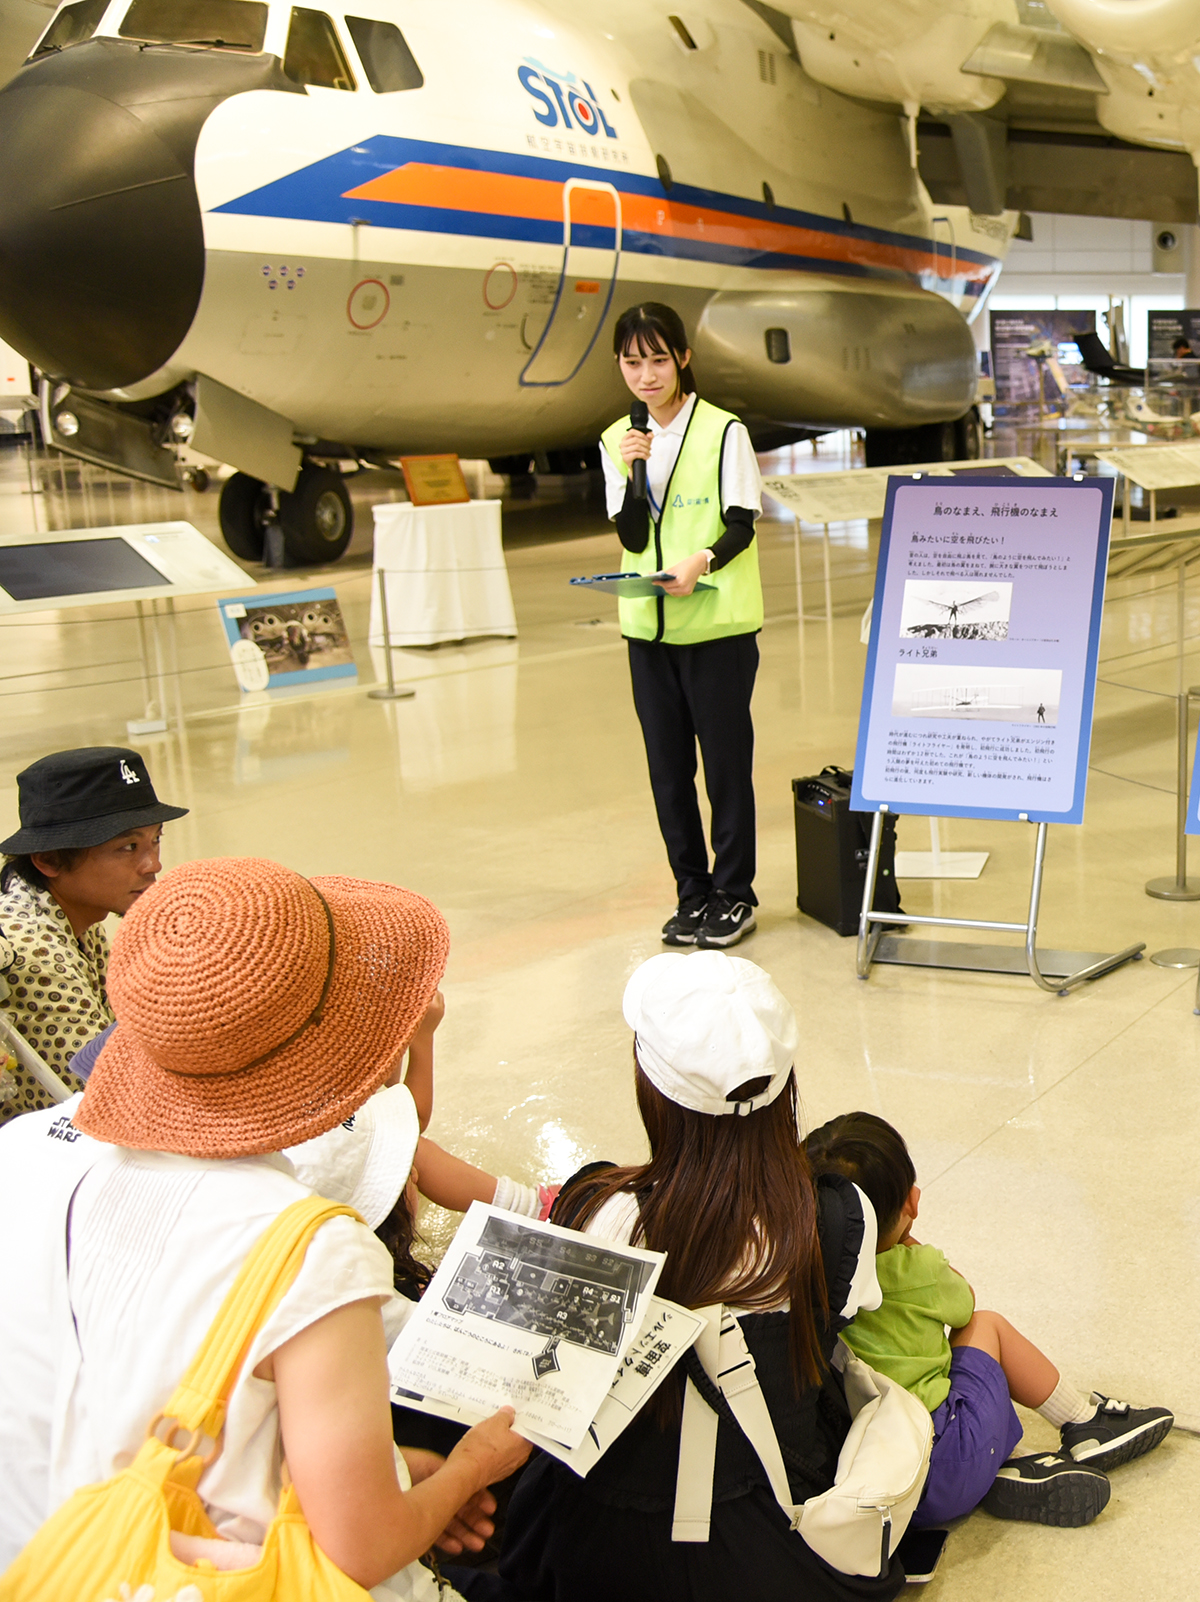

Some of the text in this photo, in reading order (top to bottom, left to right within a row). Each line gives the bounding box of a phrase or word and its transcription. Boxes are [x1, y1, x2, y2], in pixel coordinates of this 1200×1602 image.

[518, 65, 618, 139] STOL
[932, 505, 1059, 517] 鳥のなまえ、飛行機のなまえ
[910, 534, 1005, 545] 鳥みたいに空を飛びたい！
[899, 649, 937, 657] ライト兄弟
[119, 759, 140, 785] LA
[53, 1116, 82, 1132] STA
[47, 1127, 82, 1143] WARS
[492, 1260, 505, 1270] A2
[488, 1285, 501, 1295] A1
[556, 1310, 568, 1320] A3
[634, 1339, 671, 1378] 空宙博
[1105, 1398, 1126, 1411] N
[1035, 1456, 1065, 1468] N
